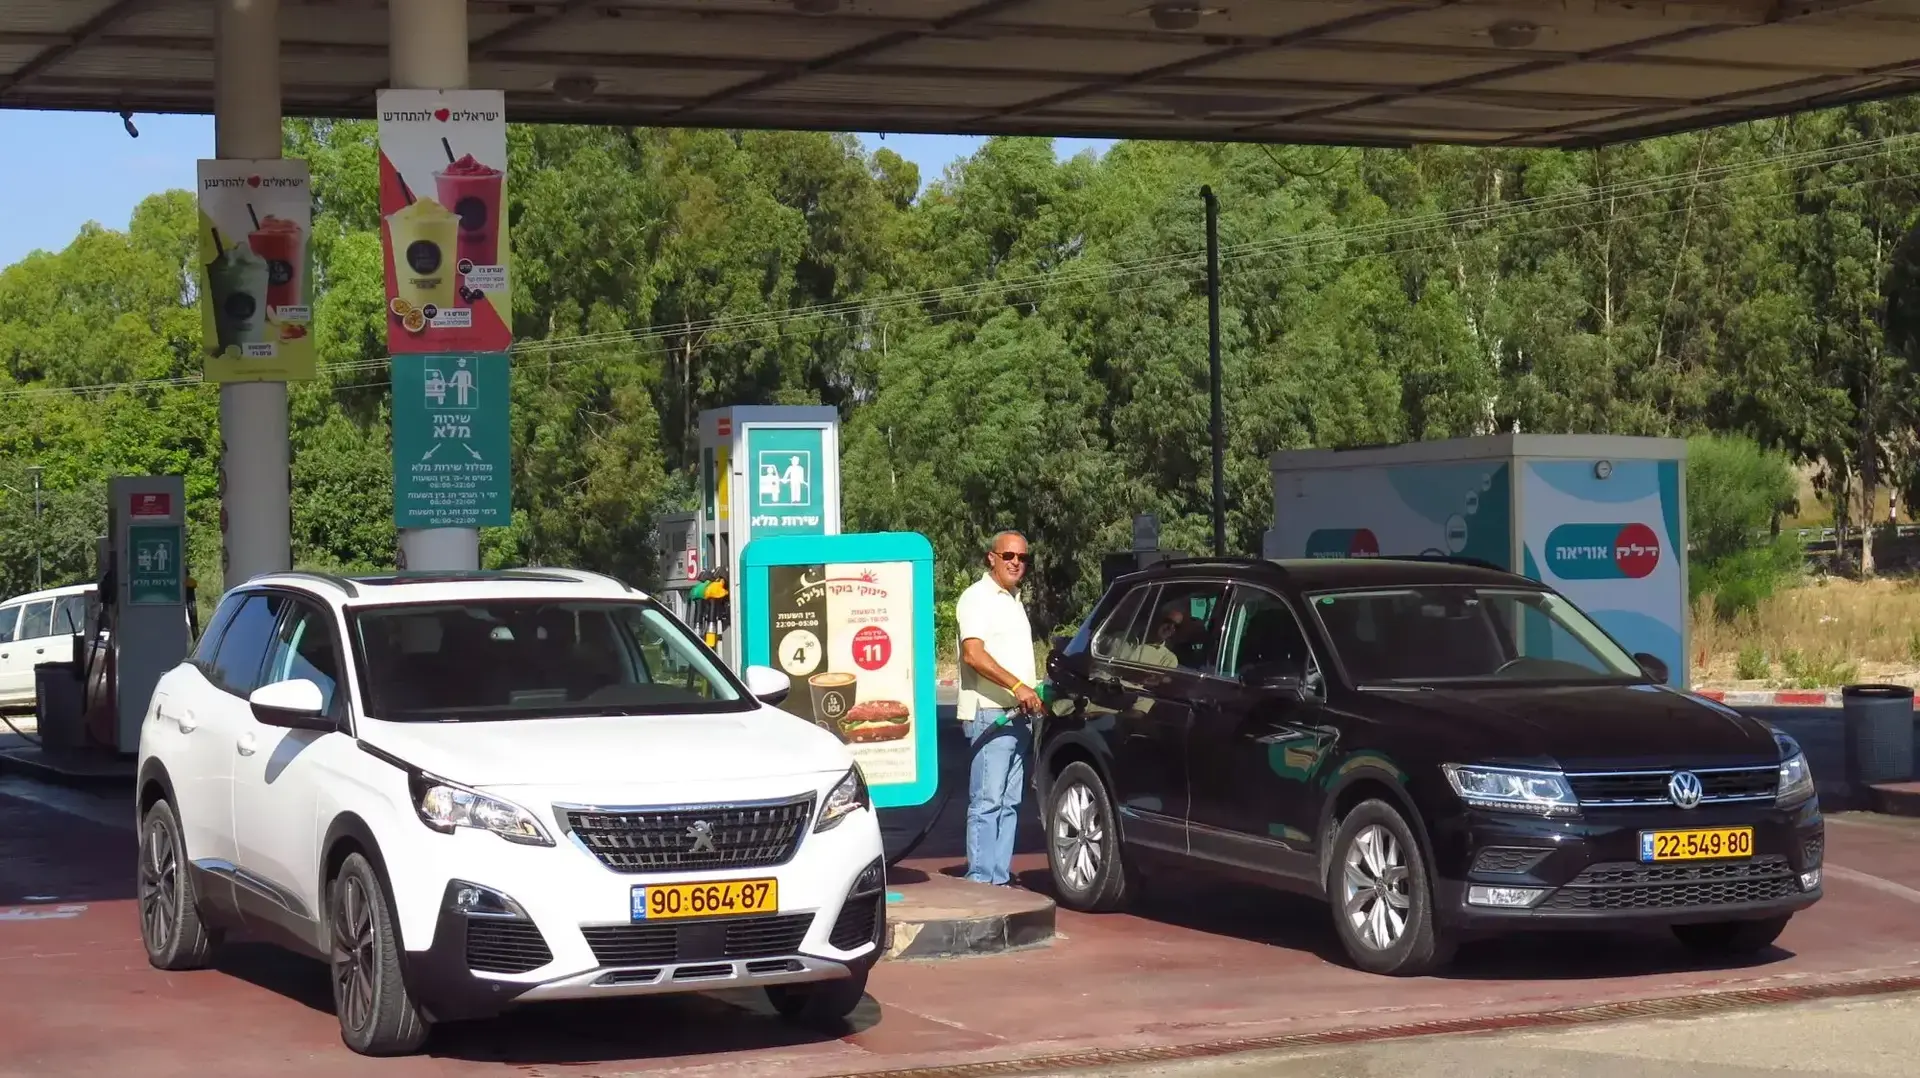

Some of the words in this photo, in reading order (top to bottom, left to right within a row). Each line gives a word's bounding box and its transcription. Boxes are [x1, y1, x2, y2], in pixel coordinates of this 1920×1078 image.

[383, 109, 432, 122] להתחדש
[452, 109, 499, 121] ישראלים
[204, 177, 245, 189] להתרענן
[263, 176, 304, 187] ישראלים
[433, 414, 471, 424] שירות
[433, 424, 471, 438] מלא
[412, 463, 431, 471] מלא
[465, 463, 493, 471] מסלול
[751, 514, 778, 526] מלא
[782, 515, 818, 526] שירות
[1556, 546, 1608, 560] אוריאה
[1616, 543, 1658, 560] דלק
[688, 550, 697, 579] 5
[828, 585, 853, 595] בוקר
[857, 585, 888, 598] פינוקי
[796, 586, 824, 607] ולילה
[776, 620, 819, 628] 22:00-05:00
[793, 647, 806, 663] 4
[863, 644, 881, 662] 11
